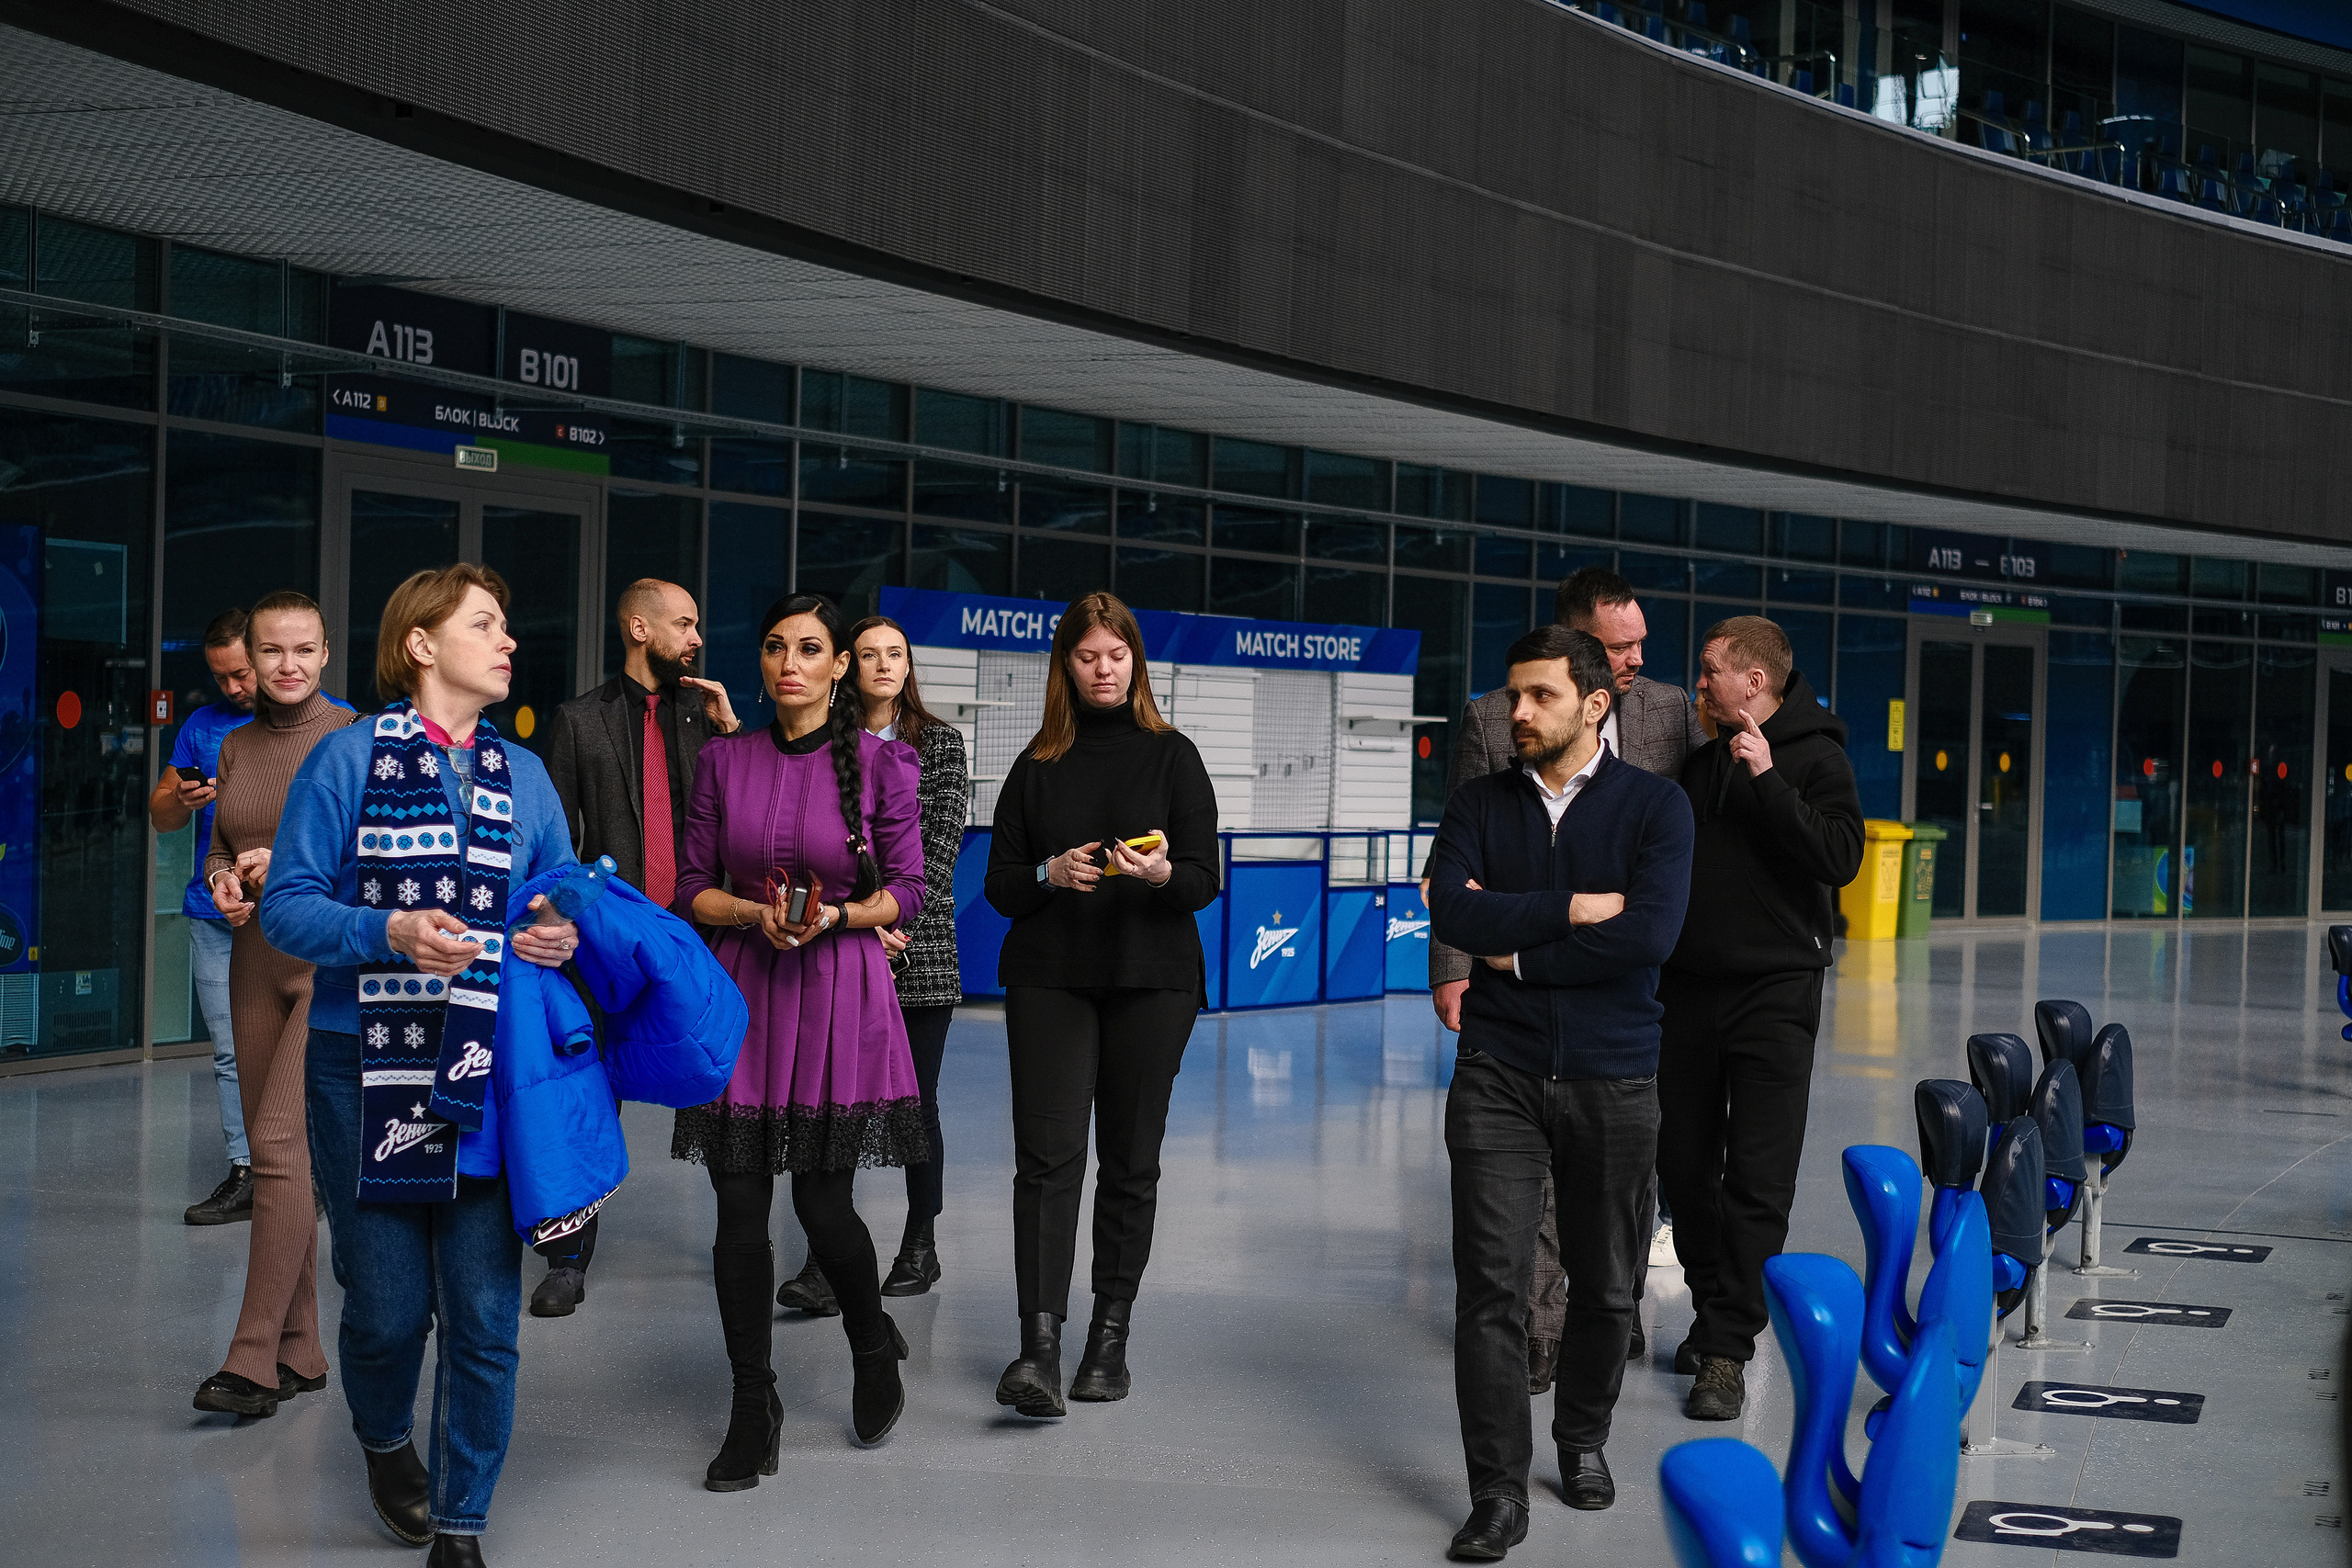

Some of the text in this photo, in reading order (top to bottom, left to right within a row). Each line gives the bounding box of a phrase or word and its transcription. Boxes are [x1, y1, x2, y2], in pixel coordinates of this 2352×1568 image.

[367, 320, 434, 366] A113
[520, 347, 579, 391] B101
[342, 390, 372, 411] A112
[435, 404, 521, 434] БЛОК BLOCK
[569, 425, 597, 446] B102
[1928, 546, 1962, 571] A113
[961, 606, 1044, 640] MATCH
[1236, 630, 1362, 661] MATCH STORE
[424, 1143, 444, 1155] 1925
